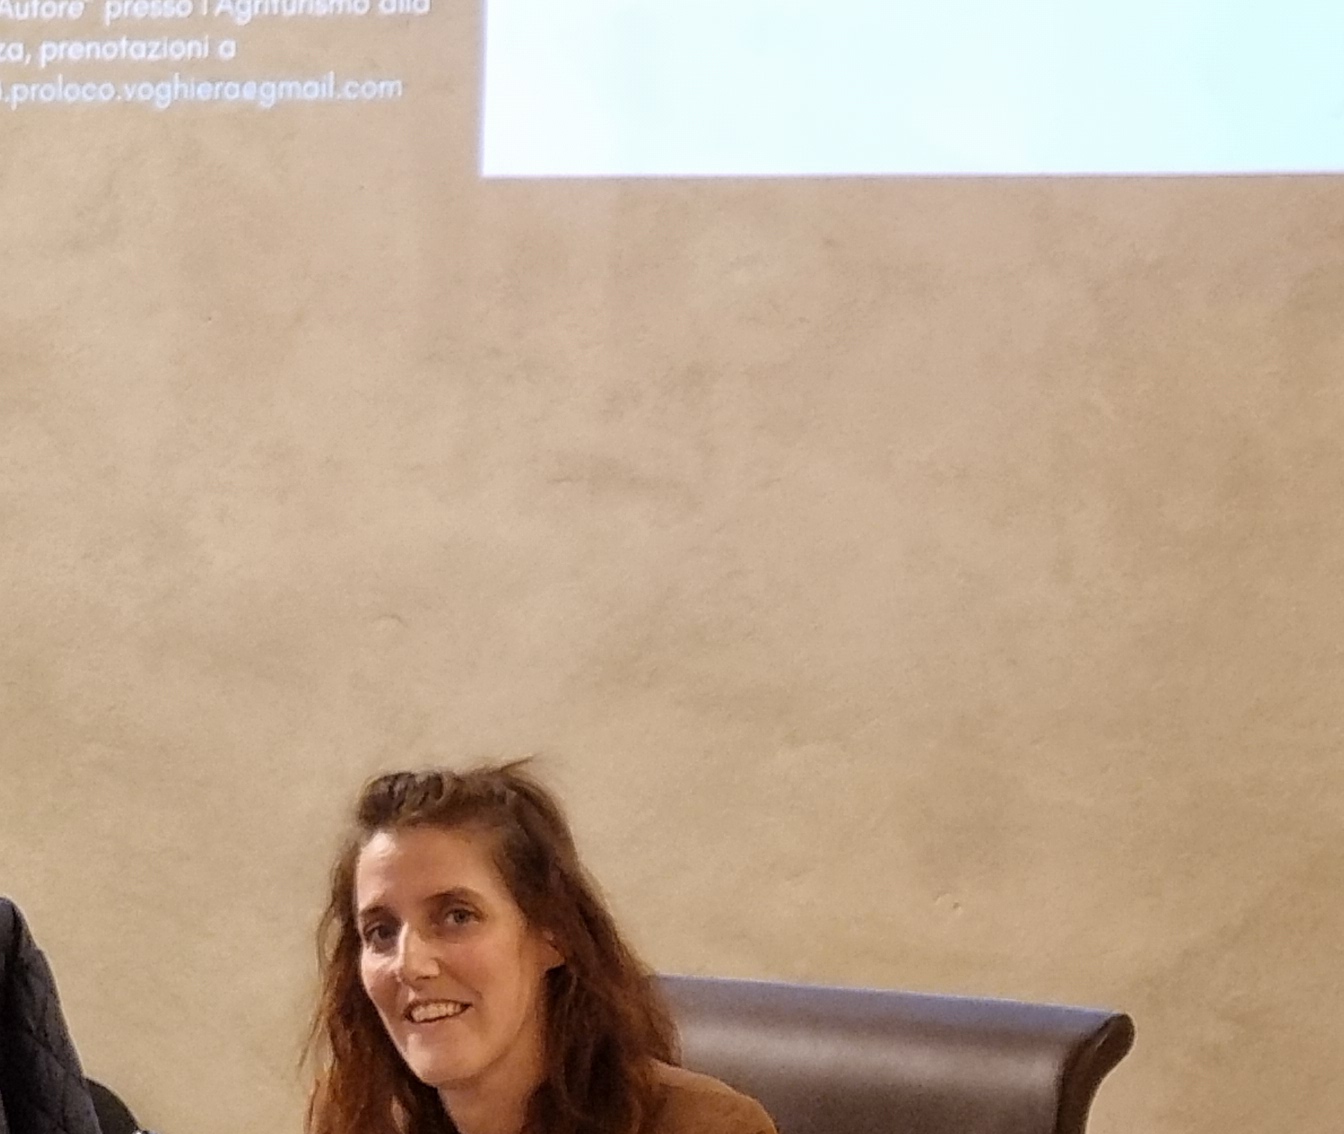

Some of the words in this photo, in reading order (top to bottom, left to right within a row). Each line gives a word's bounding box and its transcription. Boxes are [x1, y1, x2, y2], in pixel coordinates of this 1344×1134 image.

[104, 0, 193, 26] presso
[40, 35, 210, 69] prenotazioni
[218, 39, 237, 60] a
